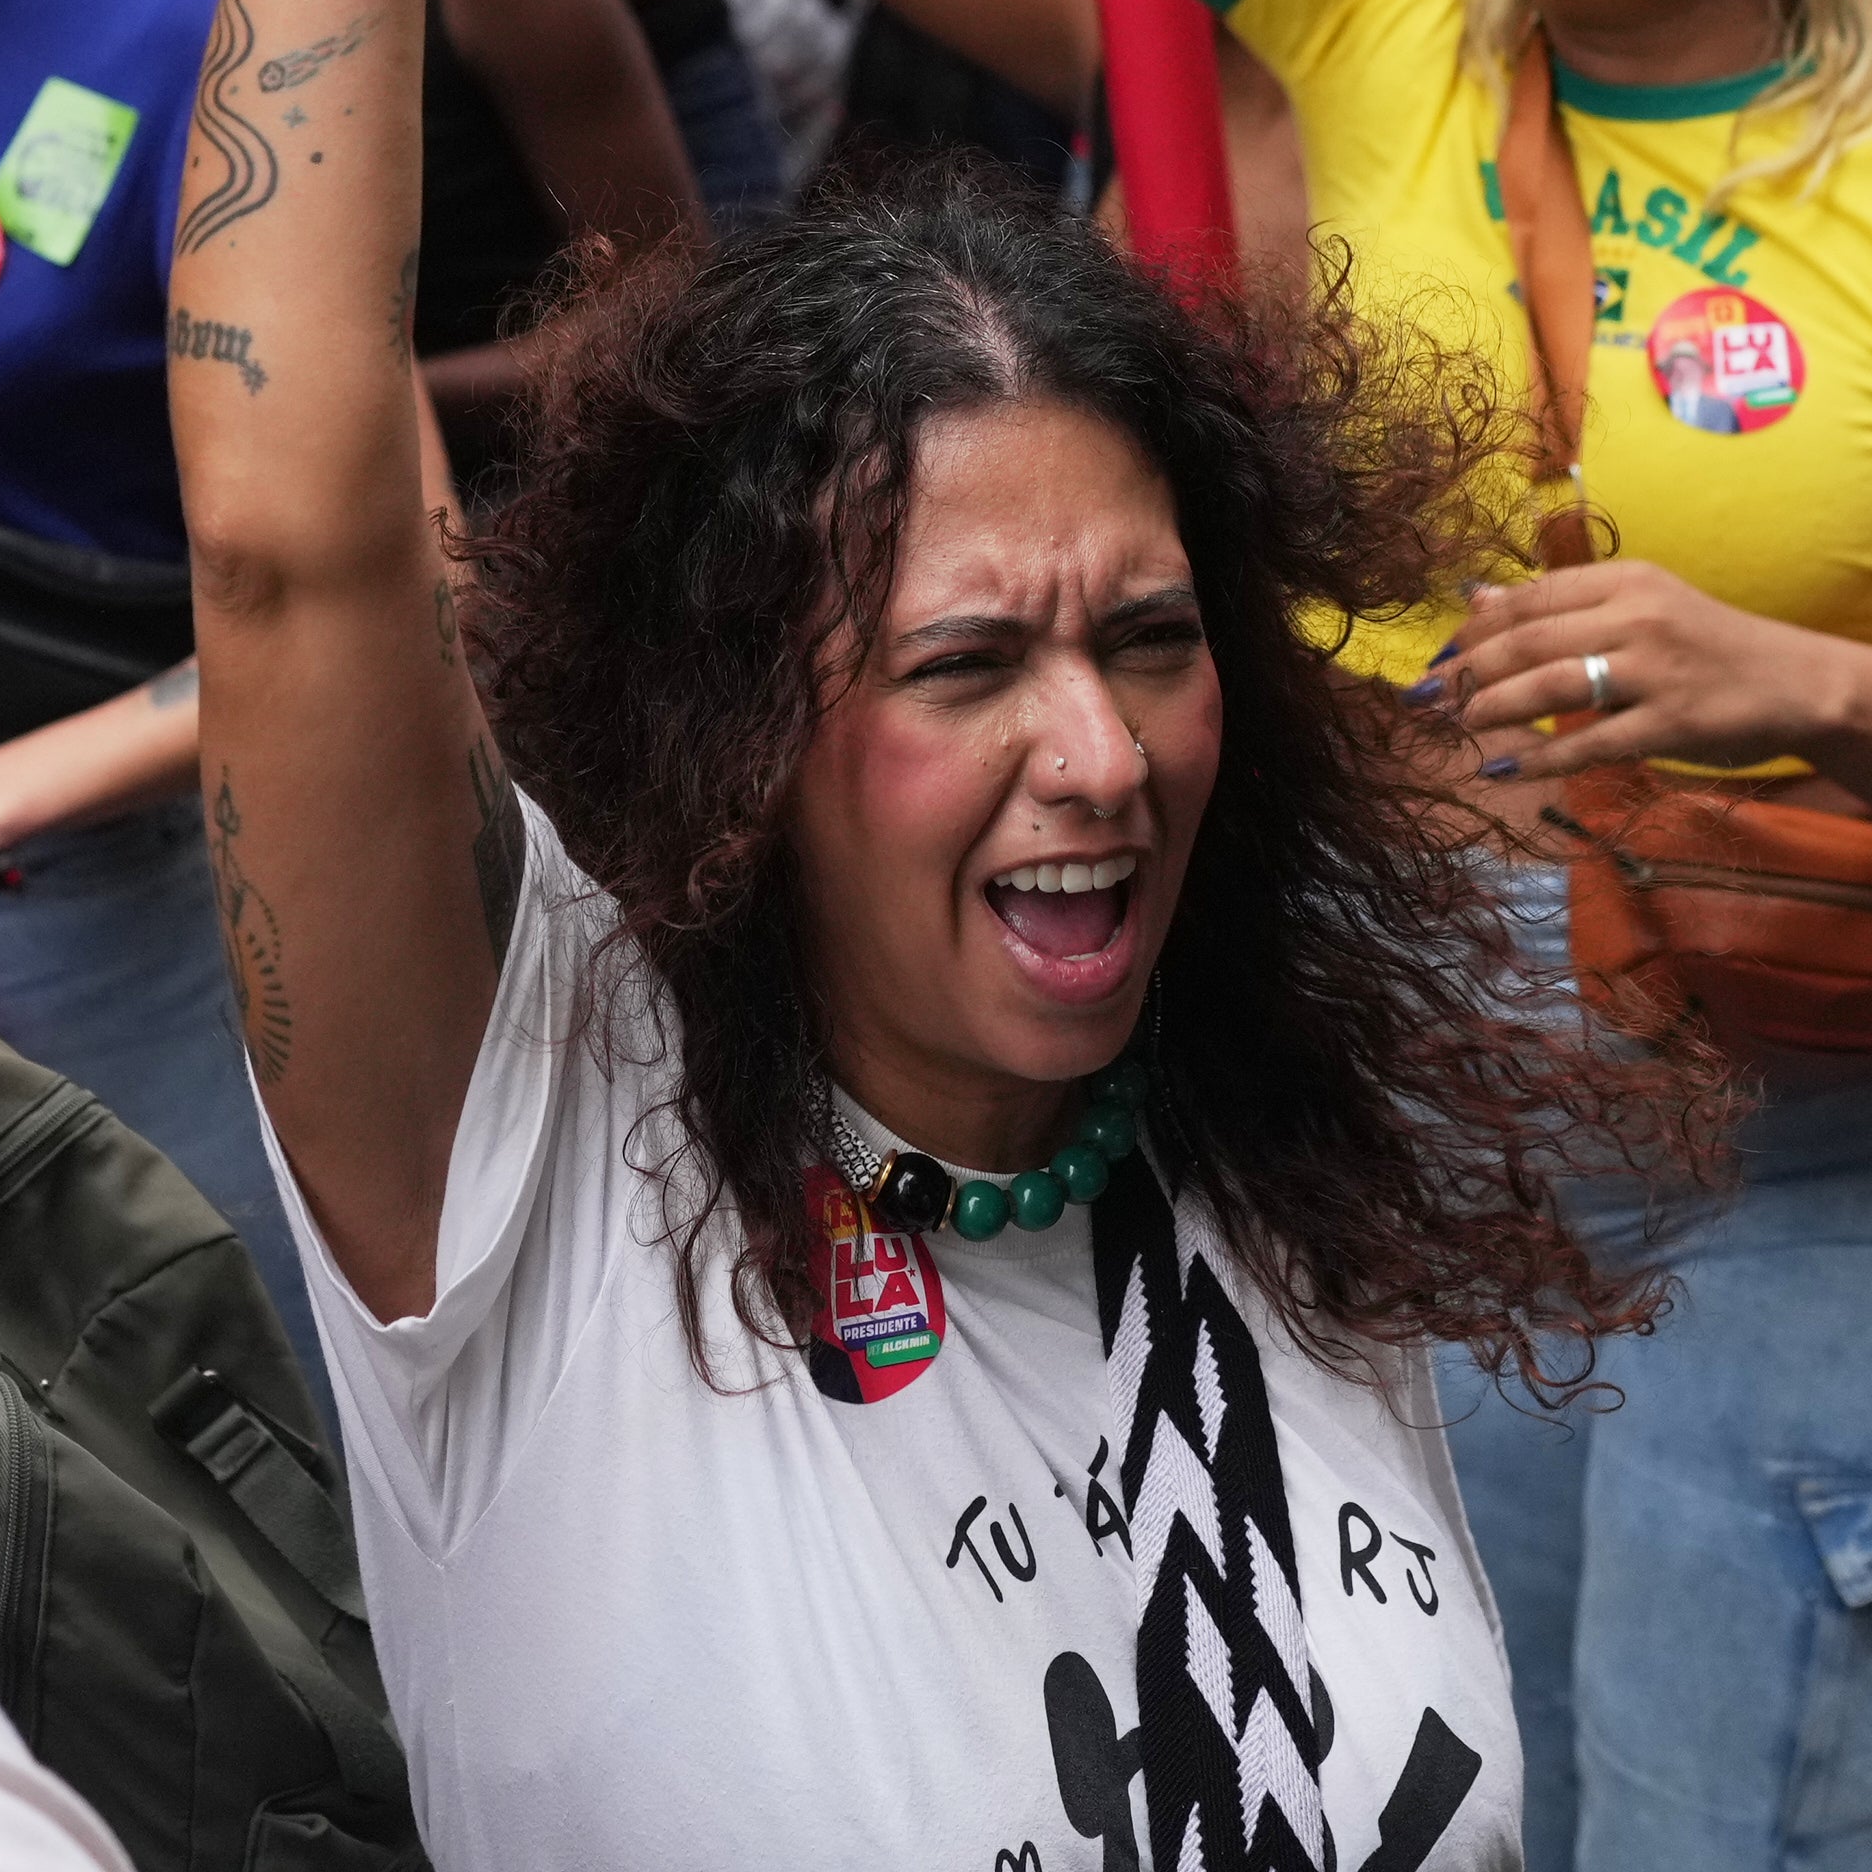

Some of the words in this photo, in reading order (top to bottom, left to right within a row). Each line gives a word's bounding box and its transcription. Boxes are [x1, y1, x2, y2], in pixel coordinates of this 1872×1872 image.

[1479, 160, 1761, 288] ASIL
[843, 1315, 918, 1342] PRESIDENTE
[881, 1333, 931, 1356] ALCKMIN
[946, 1494, 1037, 1603] TU
[1338, 1501, 1440, 1618] RJ
